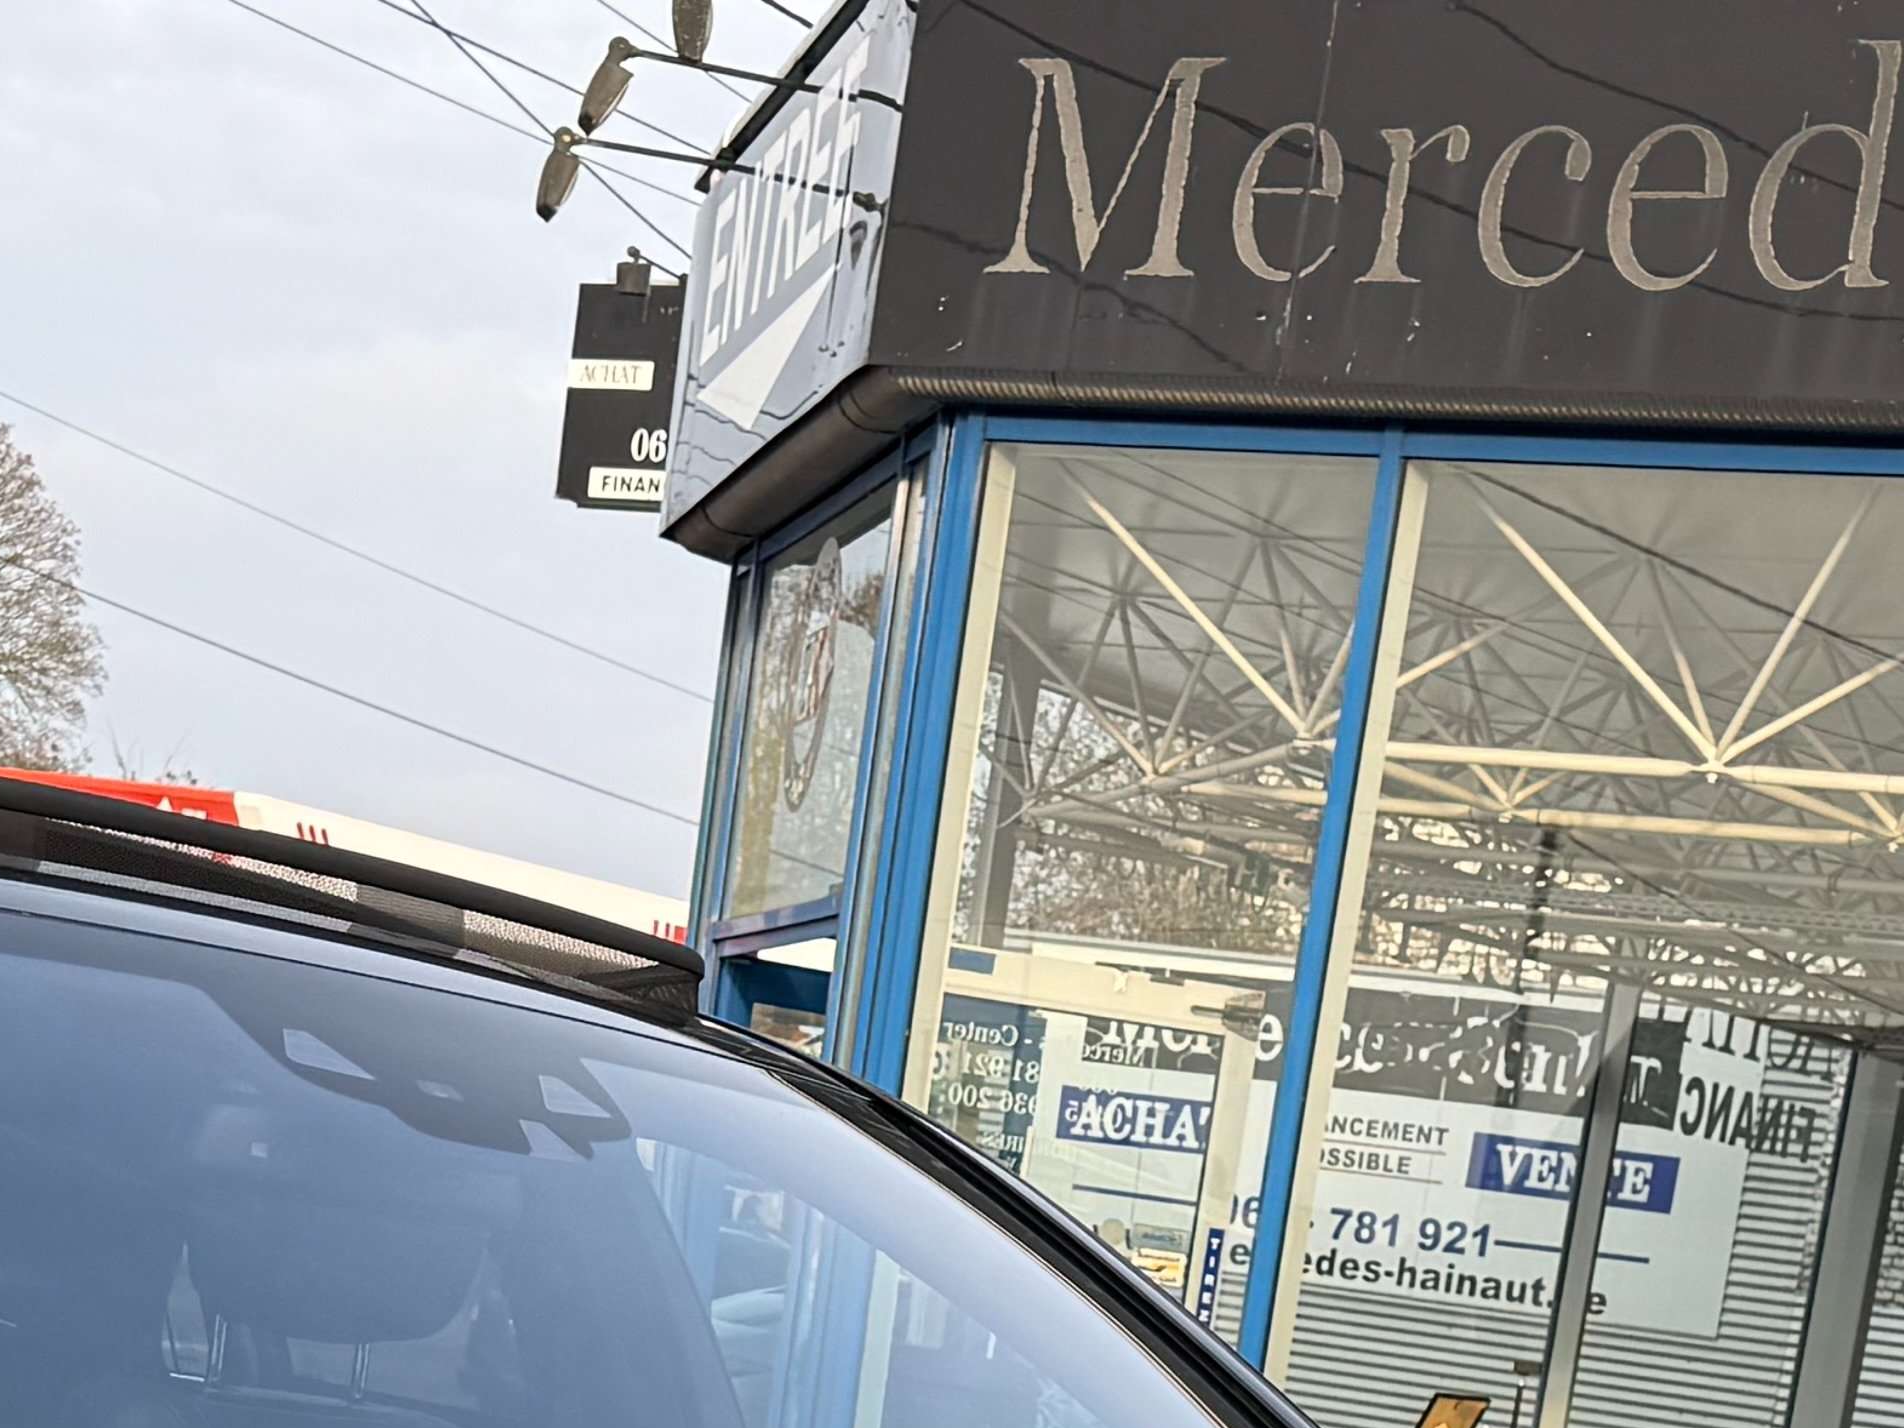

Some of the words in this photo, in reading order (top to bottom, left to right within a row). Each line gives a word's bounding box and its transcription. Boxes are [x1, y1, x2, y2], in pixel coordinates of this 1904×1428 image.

[700, 33, 872, 367] ENTREE
[601, 475, 661, 493] FINAN
[1324, 1115, 1449, 1146] NCEMENT
[1320, 1147, 1413, 1175] SSIBLE
[1329, 1207, 1400, 1248] 781
[1417, 1217, 1493, 1257] 921
